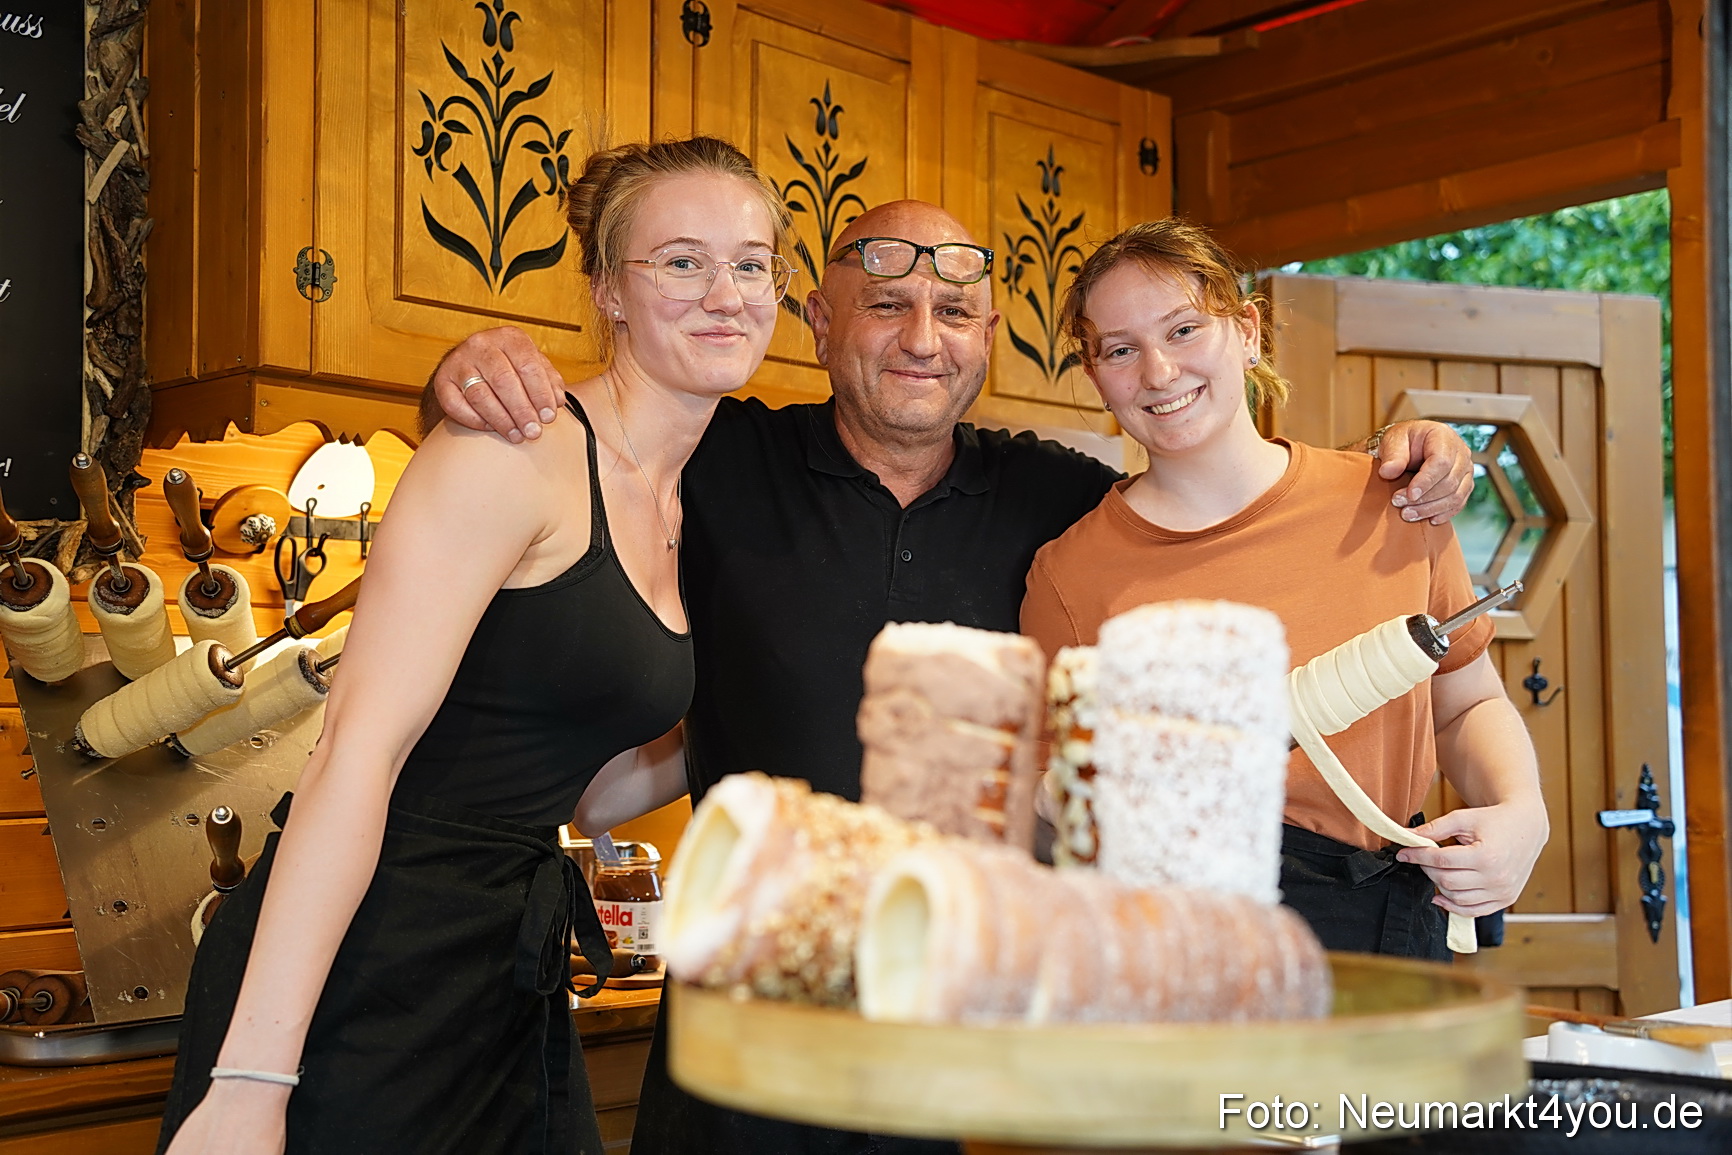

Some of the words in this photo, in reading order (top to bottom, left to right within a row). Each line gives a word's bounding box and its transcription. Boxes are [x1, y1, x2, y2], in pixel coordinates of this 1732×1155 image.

[0, 13, 44, 39] uss
[0, 87, 27, 124] el
[597, 903, 633, 927] tella
